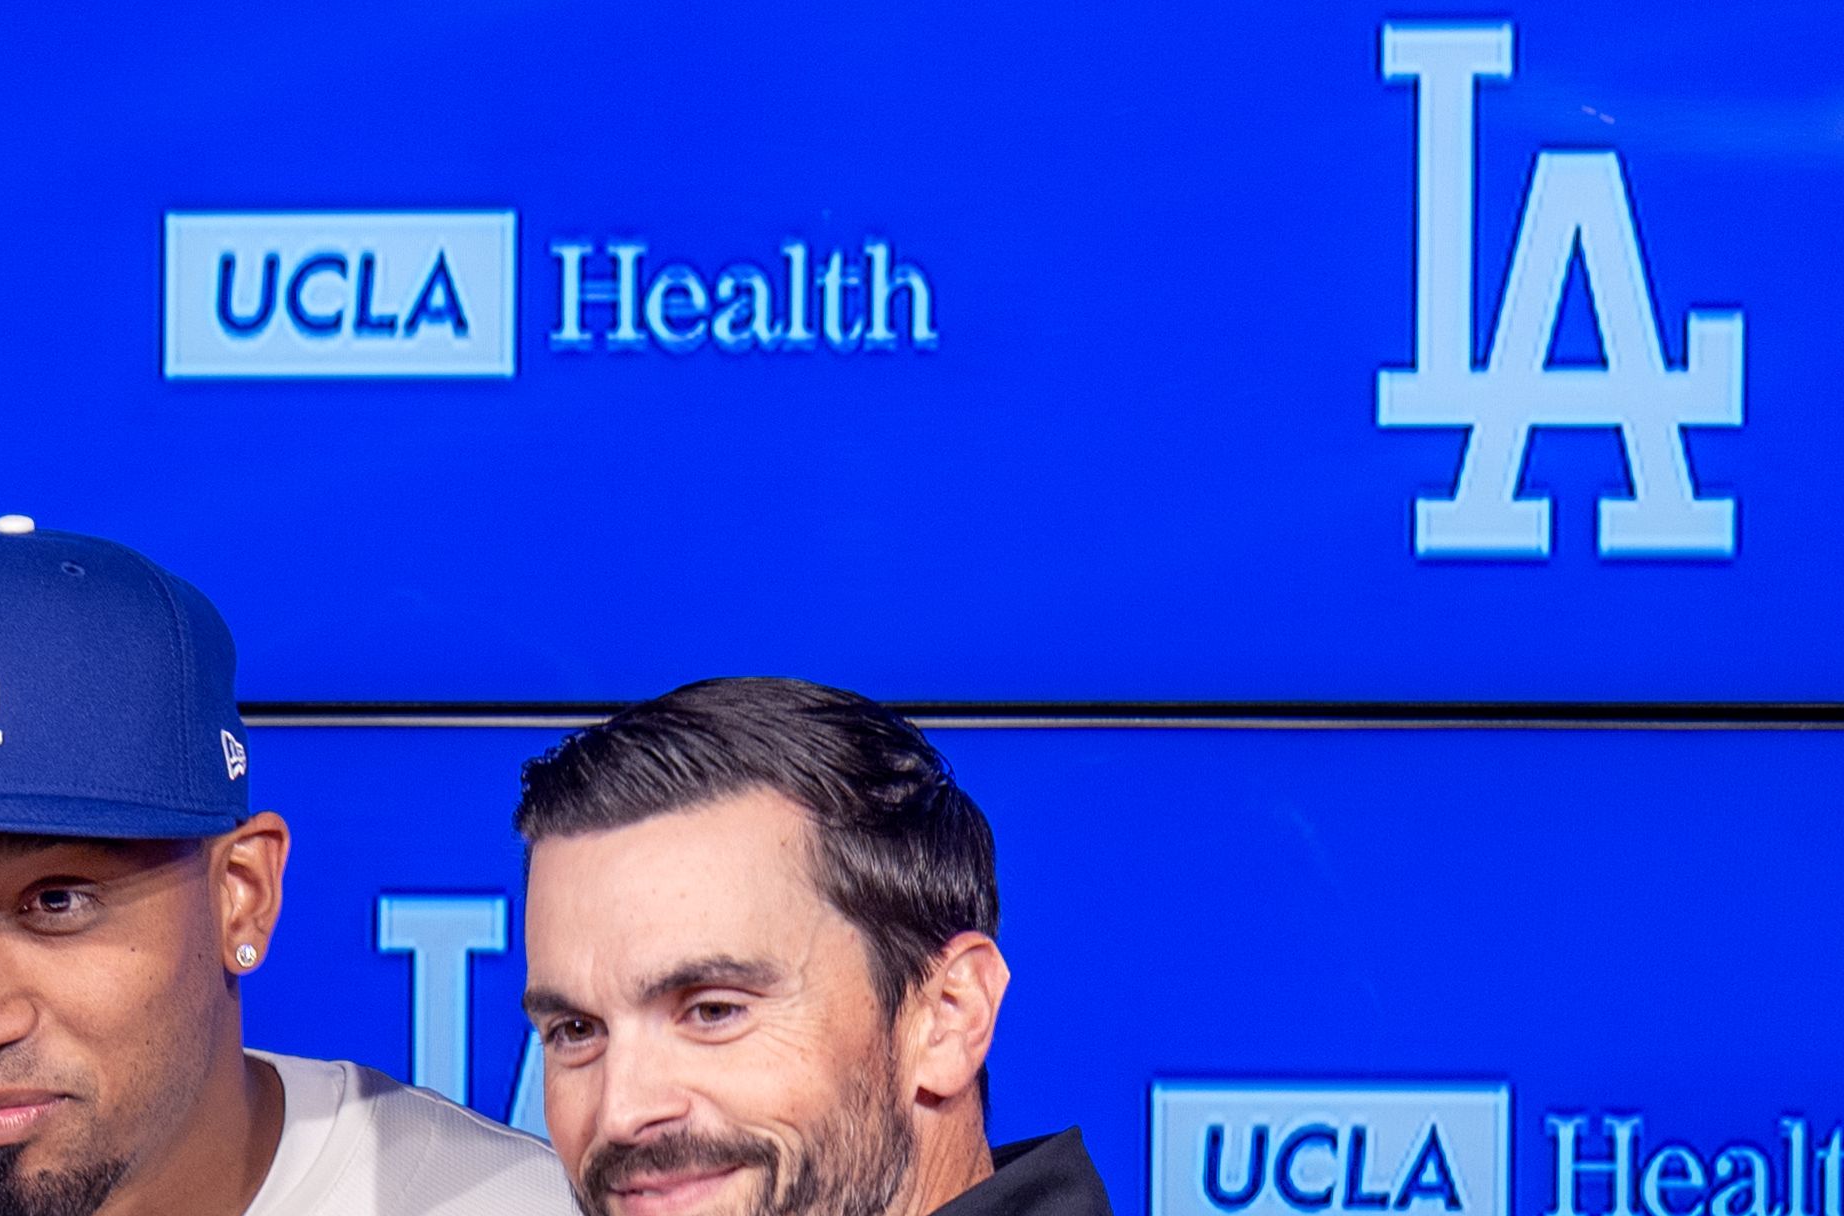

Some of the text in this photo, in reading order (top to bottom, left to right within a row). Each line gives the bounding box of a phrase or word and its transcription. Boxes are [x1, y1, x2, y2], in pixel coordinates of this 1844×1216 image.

[215, 240, 939, 350] UCLA Health
[1376, 22, 1746, 558] LA
[1201, 1120, 1465, 1213] UCLA
